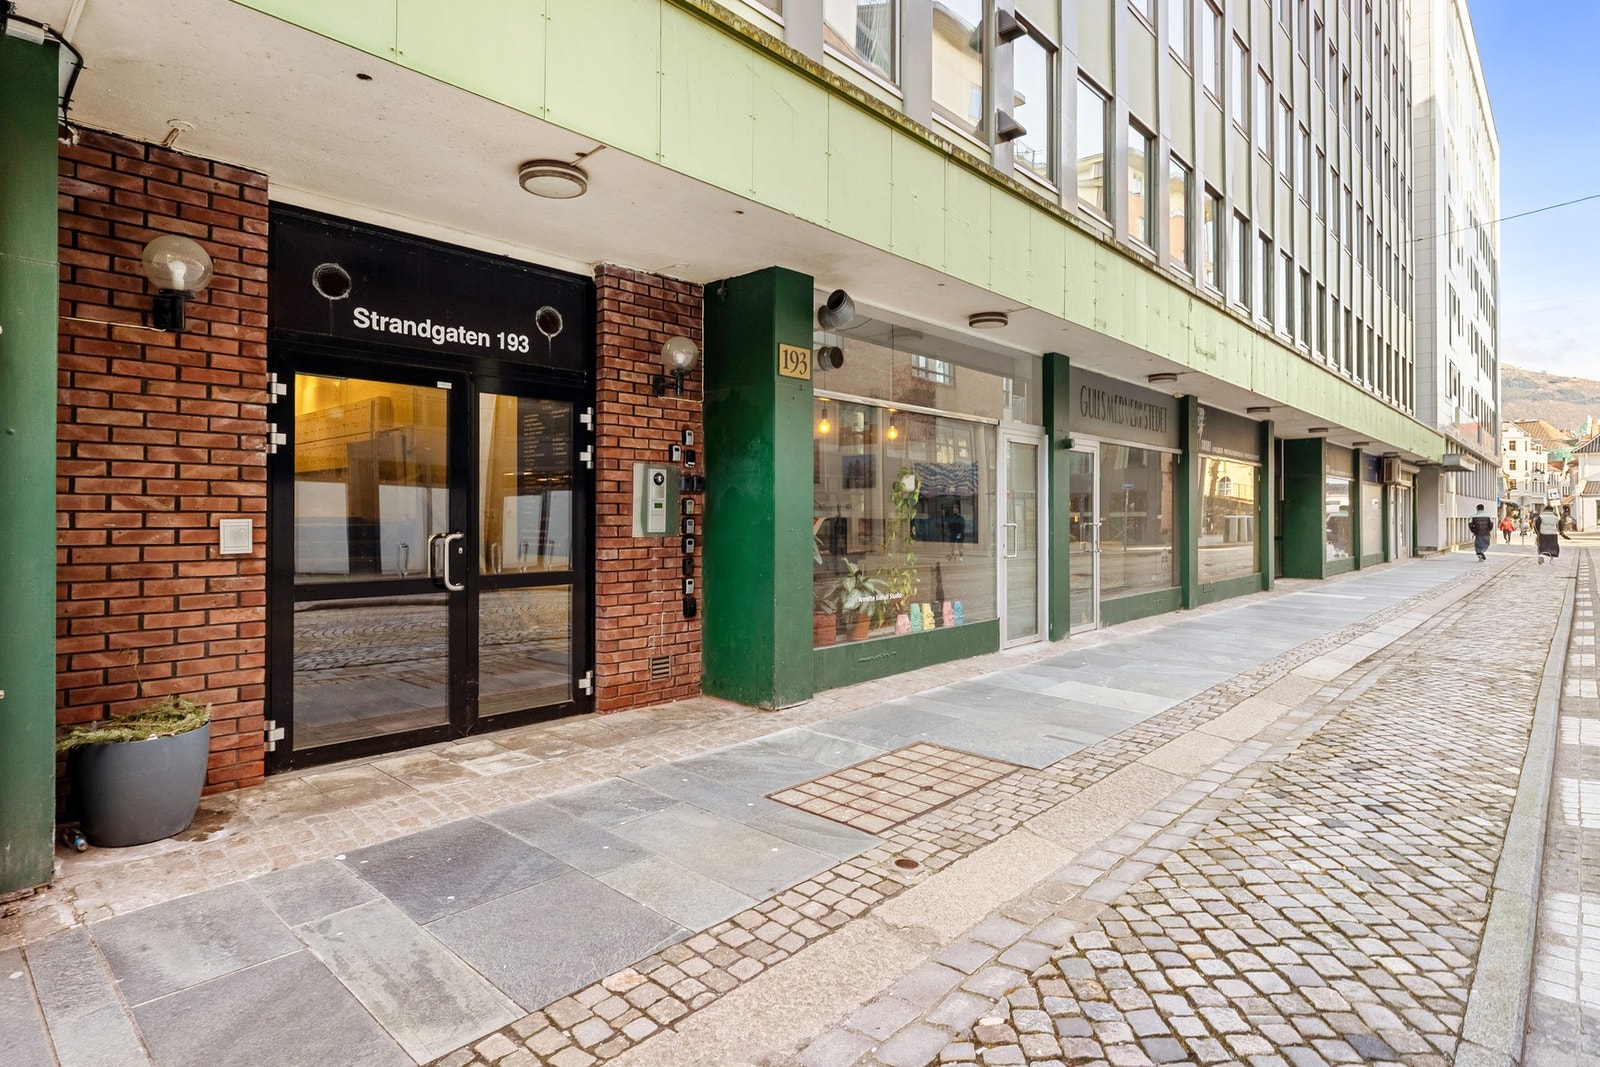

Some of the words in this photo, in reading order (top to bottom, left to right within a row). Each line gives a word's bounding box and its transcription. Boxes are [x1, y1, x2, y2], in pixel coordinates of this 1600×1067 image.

[353, 306, 490, 348] Strandgaten
[497, 331, 530, 354] 193
[782, 348, 808, 375] 193
